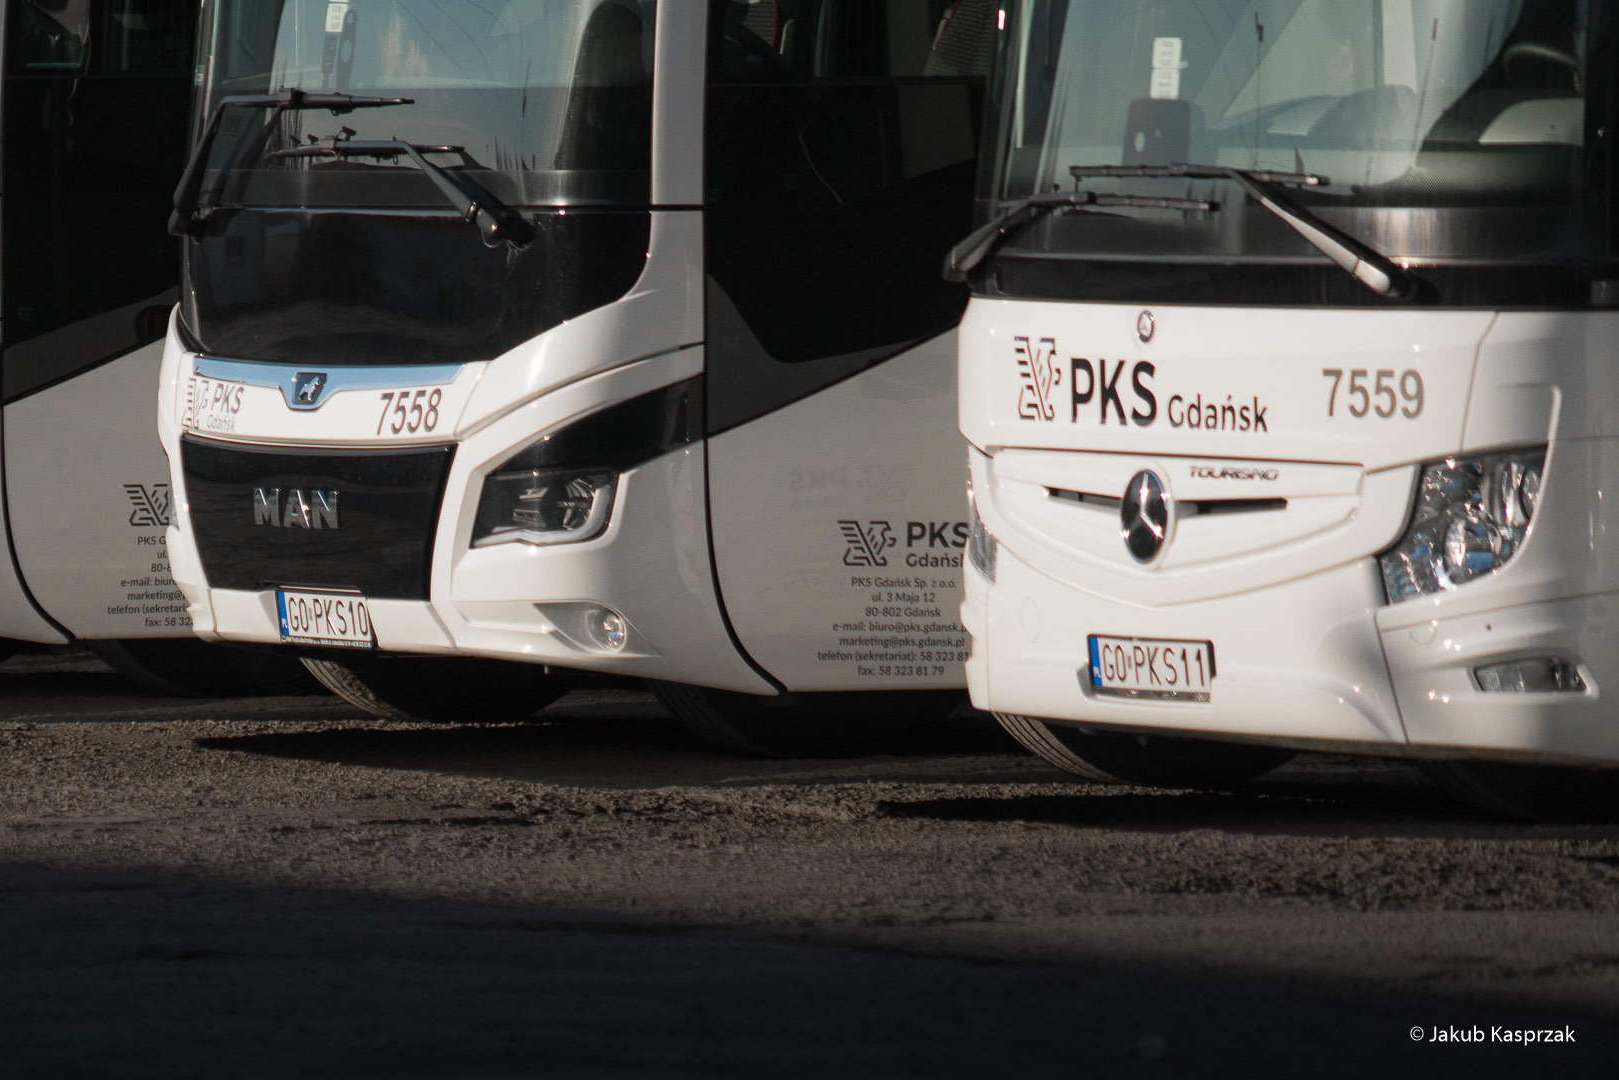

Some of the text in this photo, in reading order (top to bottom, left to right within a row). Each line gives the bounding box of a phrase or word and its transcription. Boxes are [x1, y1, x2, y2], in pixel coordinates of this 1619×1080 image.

[210, 383, 244, 414] PKS
[1070, 357, 1268, 433] PKS Gdańsk
[1321, 369, 1425, 420] 7559
[377, 388, 442, 436] 7558
[253, 487, 339, 529] MAN
[137, 536, 167, 545] PKS G
[906, 521, 969, 548] PKS
[157, 550, 168, 559] ul.
[151, 563, 172, 573] 80-8
[120, 576, 177, 587] e-mail: biur
[851, 576, 957, 589] PKS Gdańsk Sp. z o.o.
[127, 590, 186, 602] marketing@
[872, 592, 936, 604] ul. 3 Maja 12
[107, 604, 140, 614] telefon
[865, 606, 941, 618] 80-802 Gdańsk
[144, 616, 194, 627] fax: 58 32
[832, 621, 967, 634] e-mail: biuro@pks.gdansk.p
[839, 636, 965, 648] marketing@pks.gdansk.pl
[818, 651, 969, 662] telefon (sekretariat): 58 323 81
[857, 665, 944, 676] fax: 58 323 81 79
